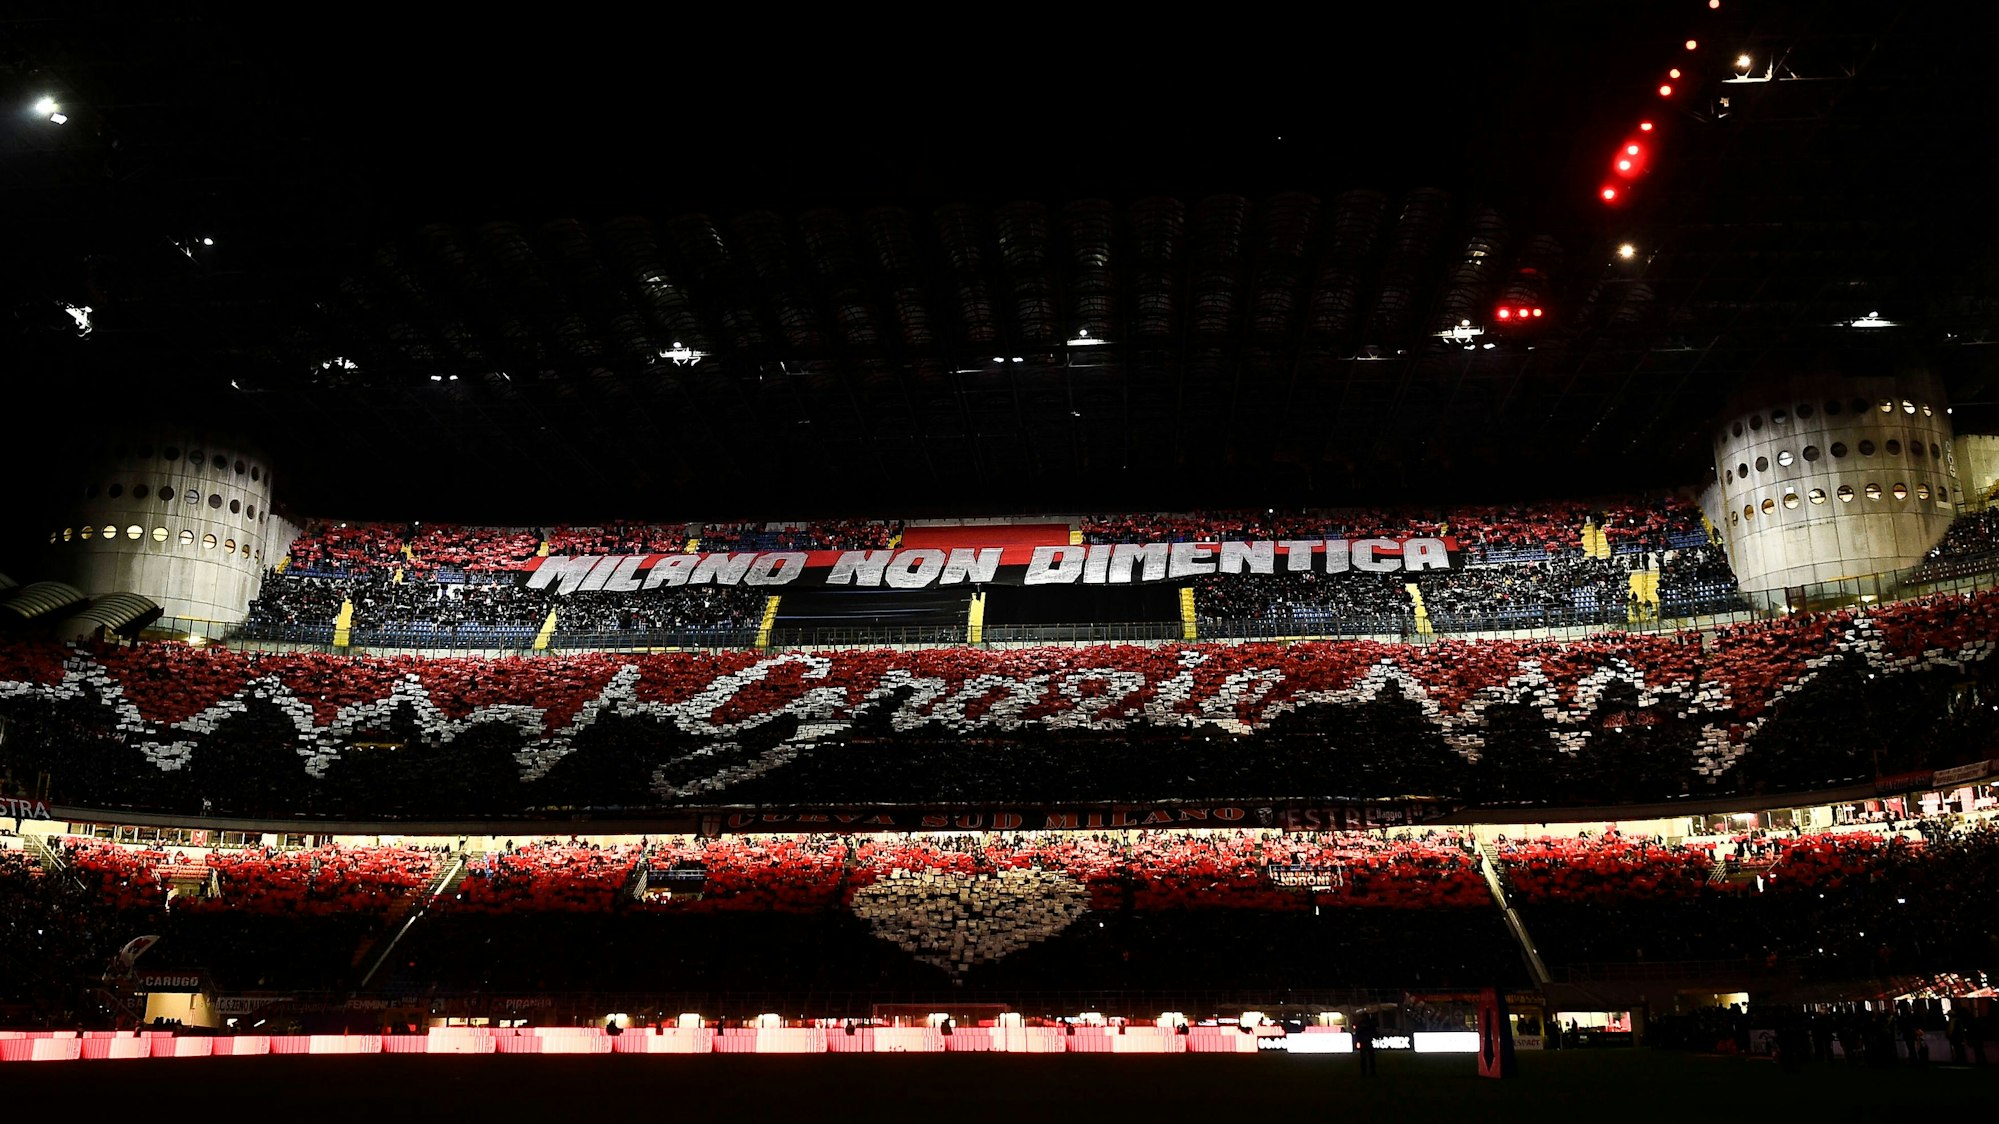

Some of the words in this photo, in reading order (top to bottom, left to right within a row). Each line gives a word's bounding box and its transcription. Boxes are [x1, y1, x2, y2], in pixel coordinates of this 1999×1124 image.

[525, 551, 808, 596] MILANO
[825, 548, 1004, 589] NON
[1024, 538, 1450, 586] DIMENTICA
[727, 812, 895, 829] CURVA
[921, 809, 1023, 830] SUD
[1043, 806, 1246, 830] MILANO
[145, 976, 199, 987] CARUGO
